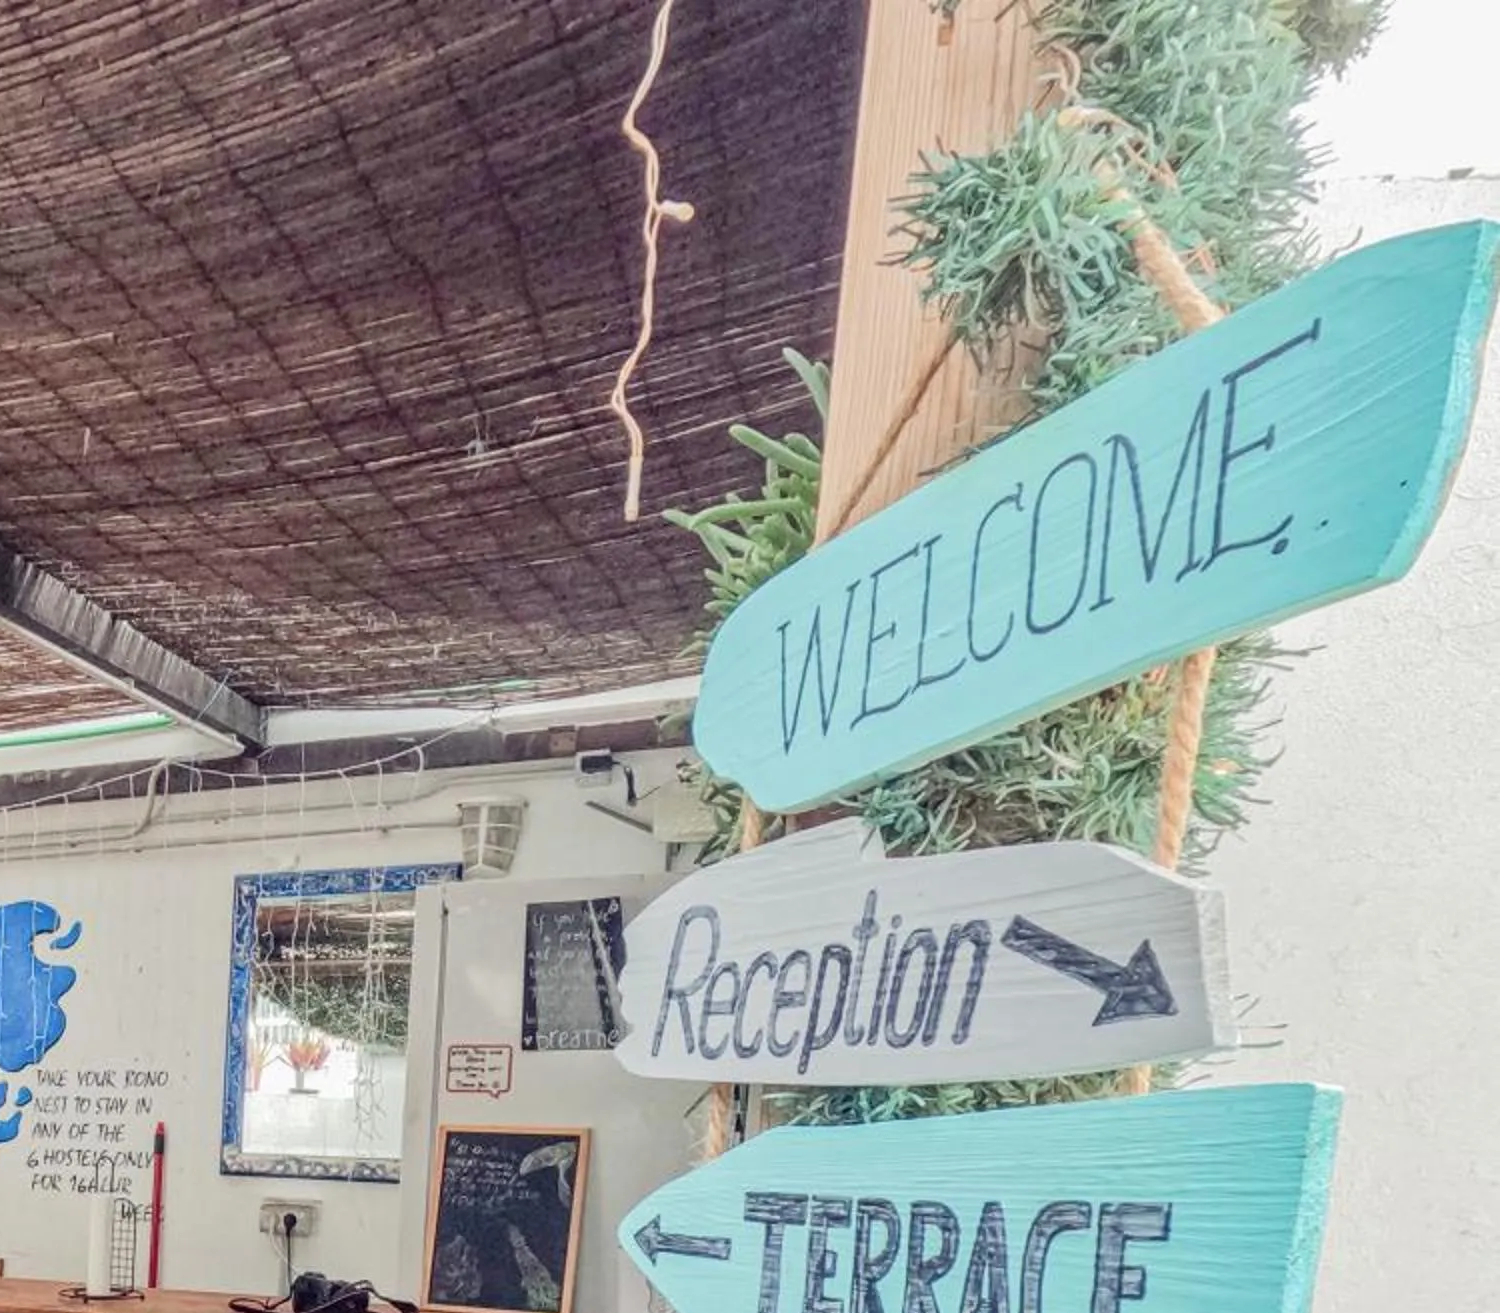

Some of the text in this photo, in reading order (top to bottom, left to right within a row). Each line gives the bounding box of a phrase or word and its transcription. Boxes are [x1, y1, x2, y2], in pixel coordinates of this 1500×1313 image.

[651, 889, 991, 1075] Reception
[36, 1069, 68, 1088] TAKE
[77, 1070, 116, 1088] YOUR
[33, 1096, 153, 1115] NEST TO STAY IN
[31, 1123, 126, 1142] ANY OF THE
[31, 1174, 61, 1192] FOR
